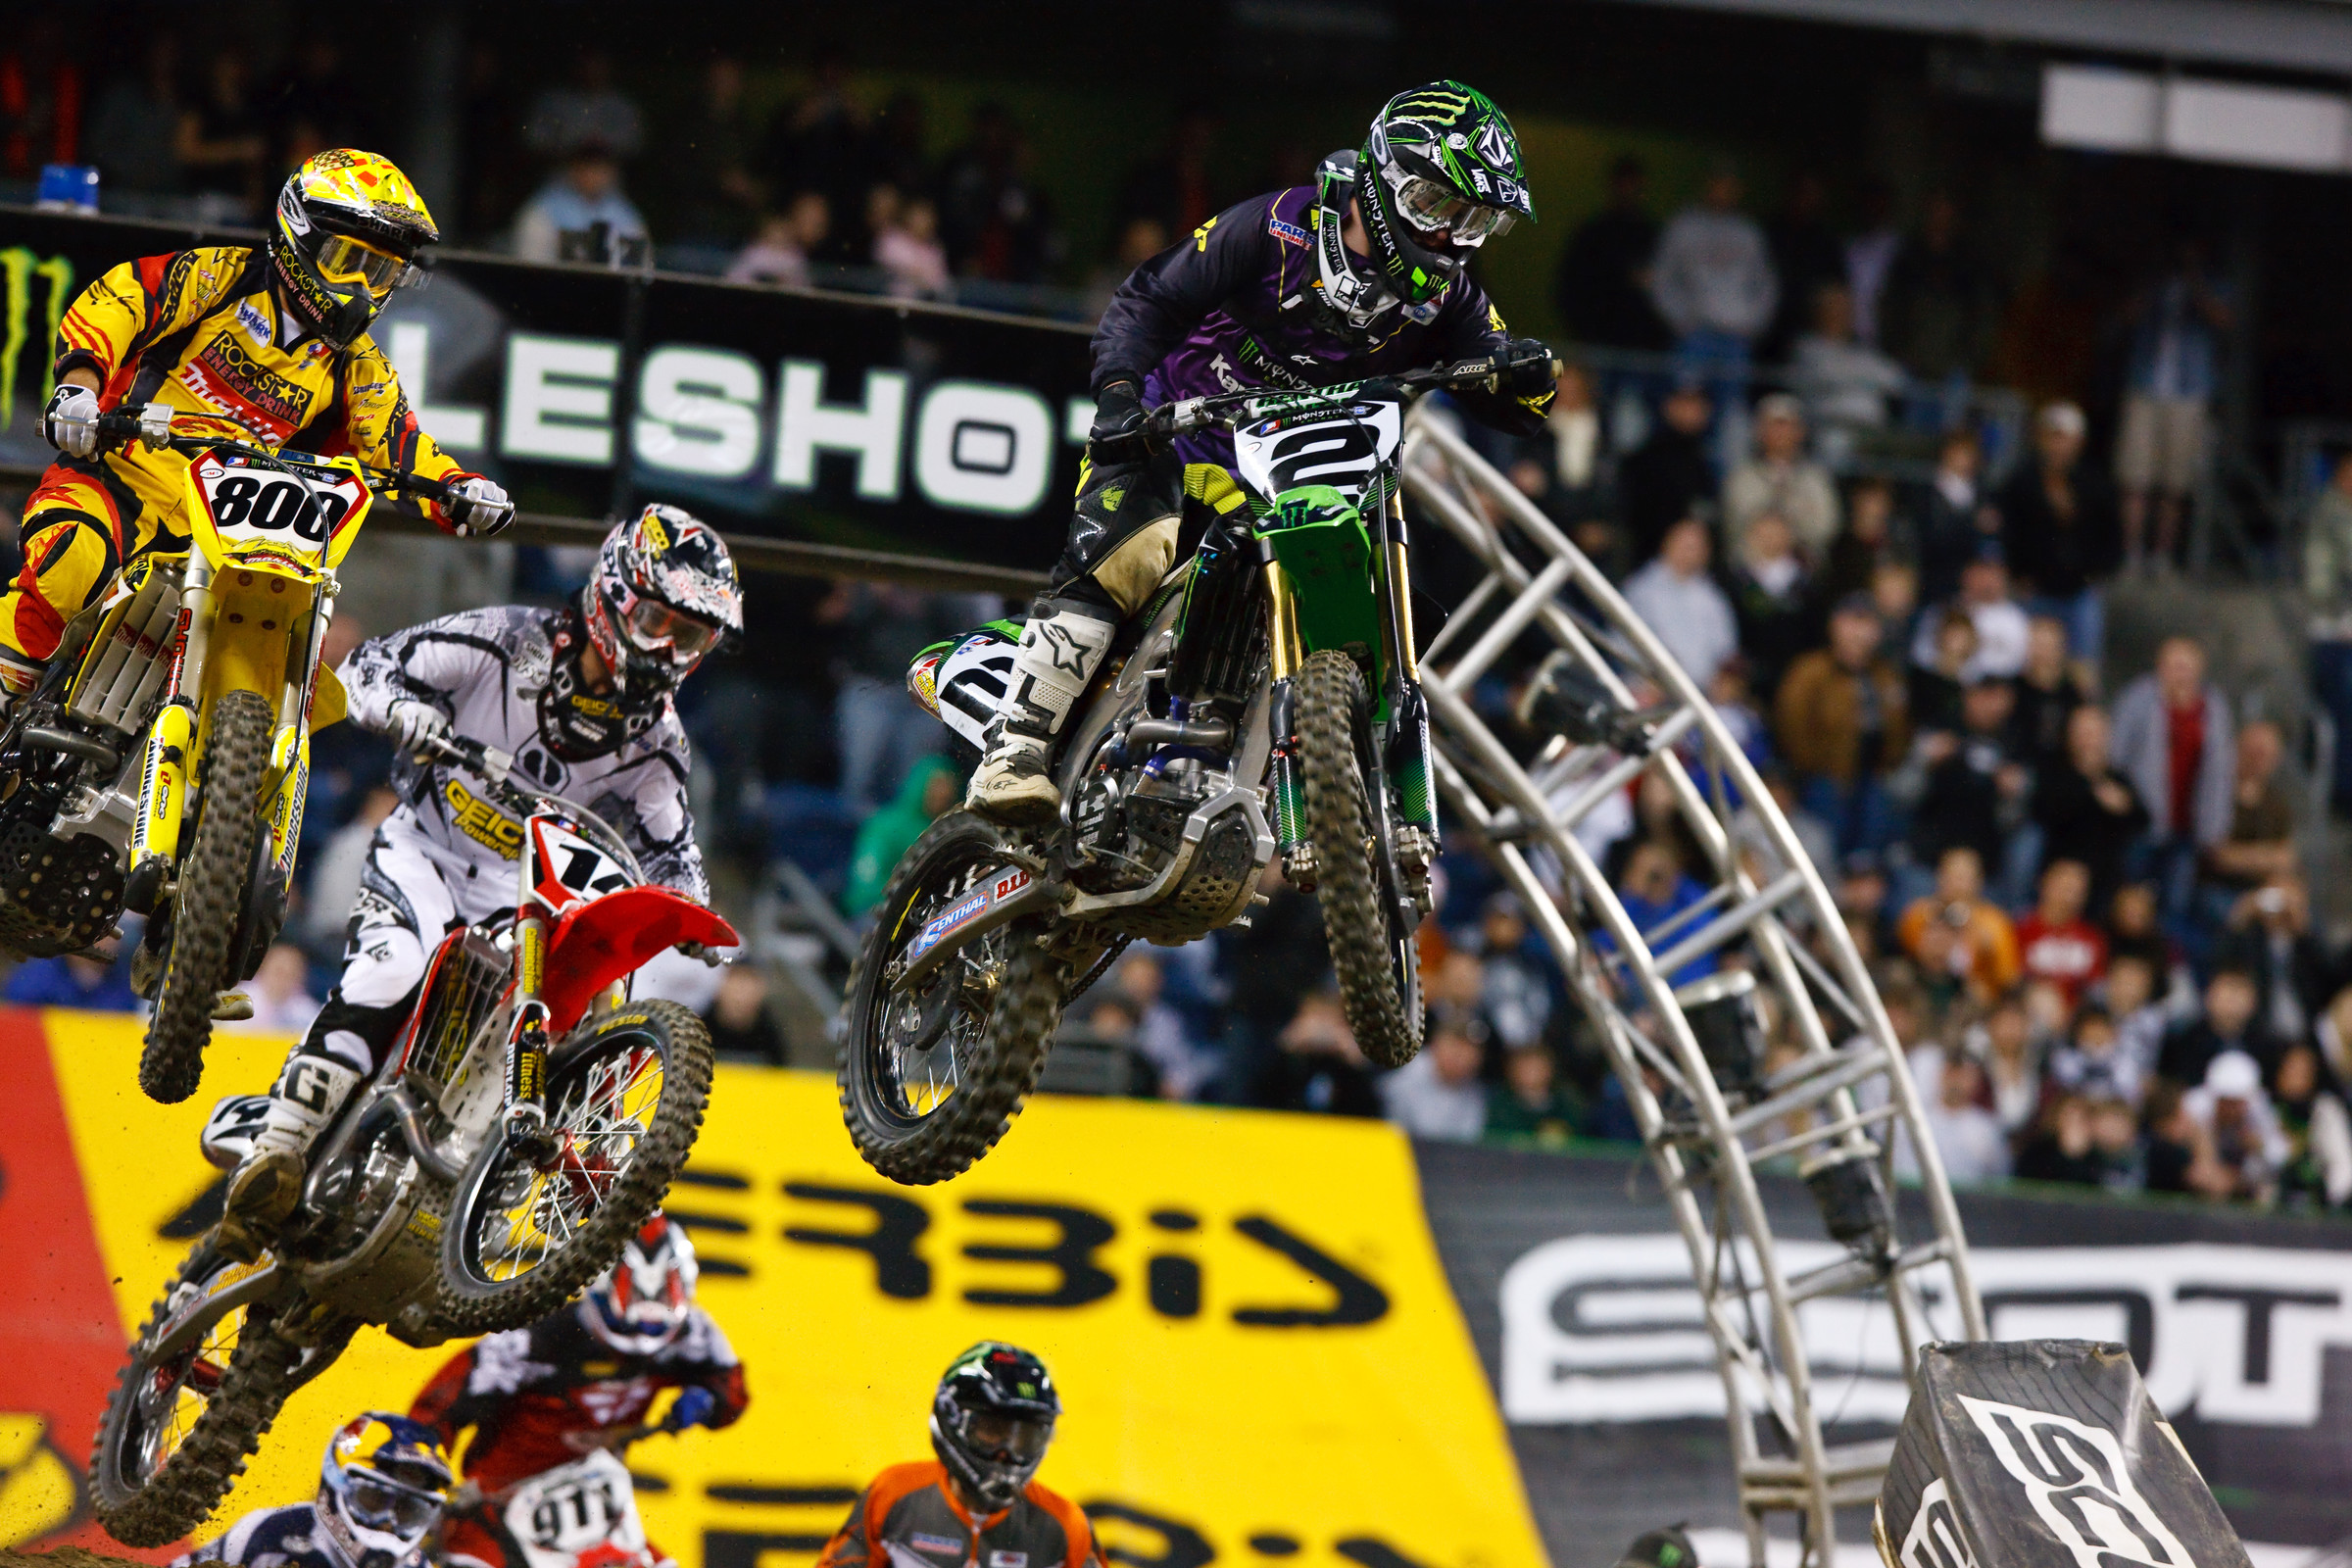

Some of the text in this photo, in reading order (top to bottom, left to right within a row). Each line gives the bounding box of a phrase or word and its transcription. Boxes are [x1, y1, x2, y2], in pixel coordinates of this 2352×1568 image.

[1363, 171, 1396, 256] MONSTER
[238, 303, 271, 339] SHARK
[274, 257, 324, 324] ENERGY DRINK
[202, 346, 301, 424] ENERGY DRINK
[1254, 355, 1313, 392] MONS
[1452, 364, 1488, 376] ARC
[392, 318, 1093, 515] LESHO
[211, 476, 349, 543] 800
[280, 759, 309, 878] BRIDGESTONE
[445, 779, 525, 846] GEIC
[453, 814, 521, 862] Powersp
[914, 892, 987, 956] RENTHAL
[504, 1042, 516, 1108] DUNLOP
[519, 1052, 535, 1100] fitness
